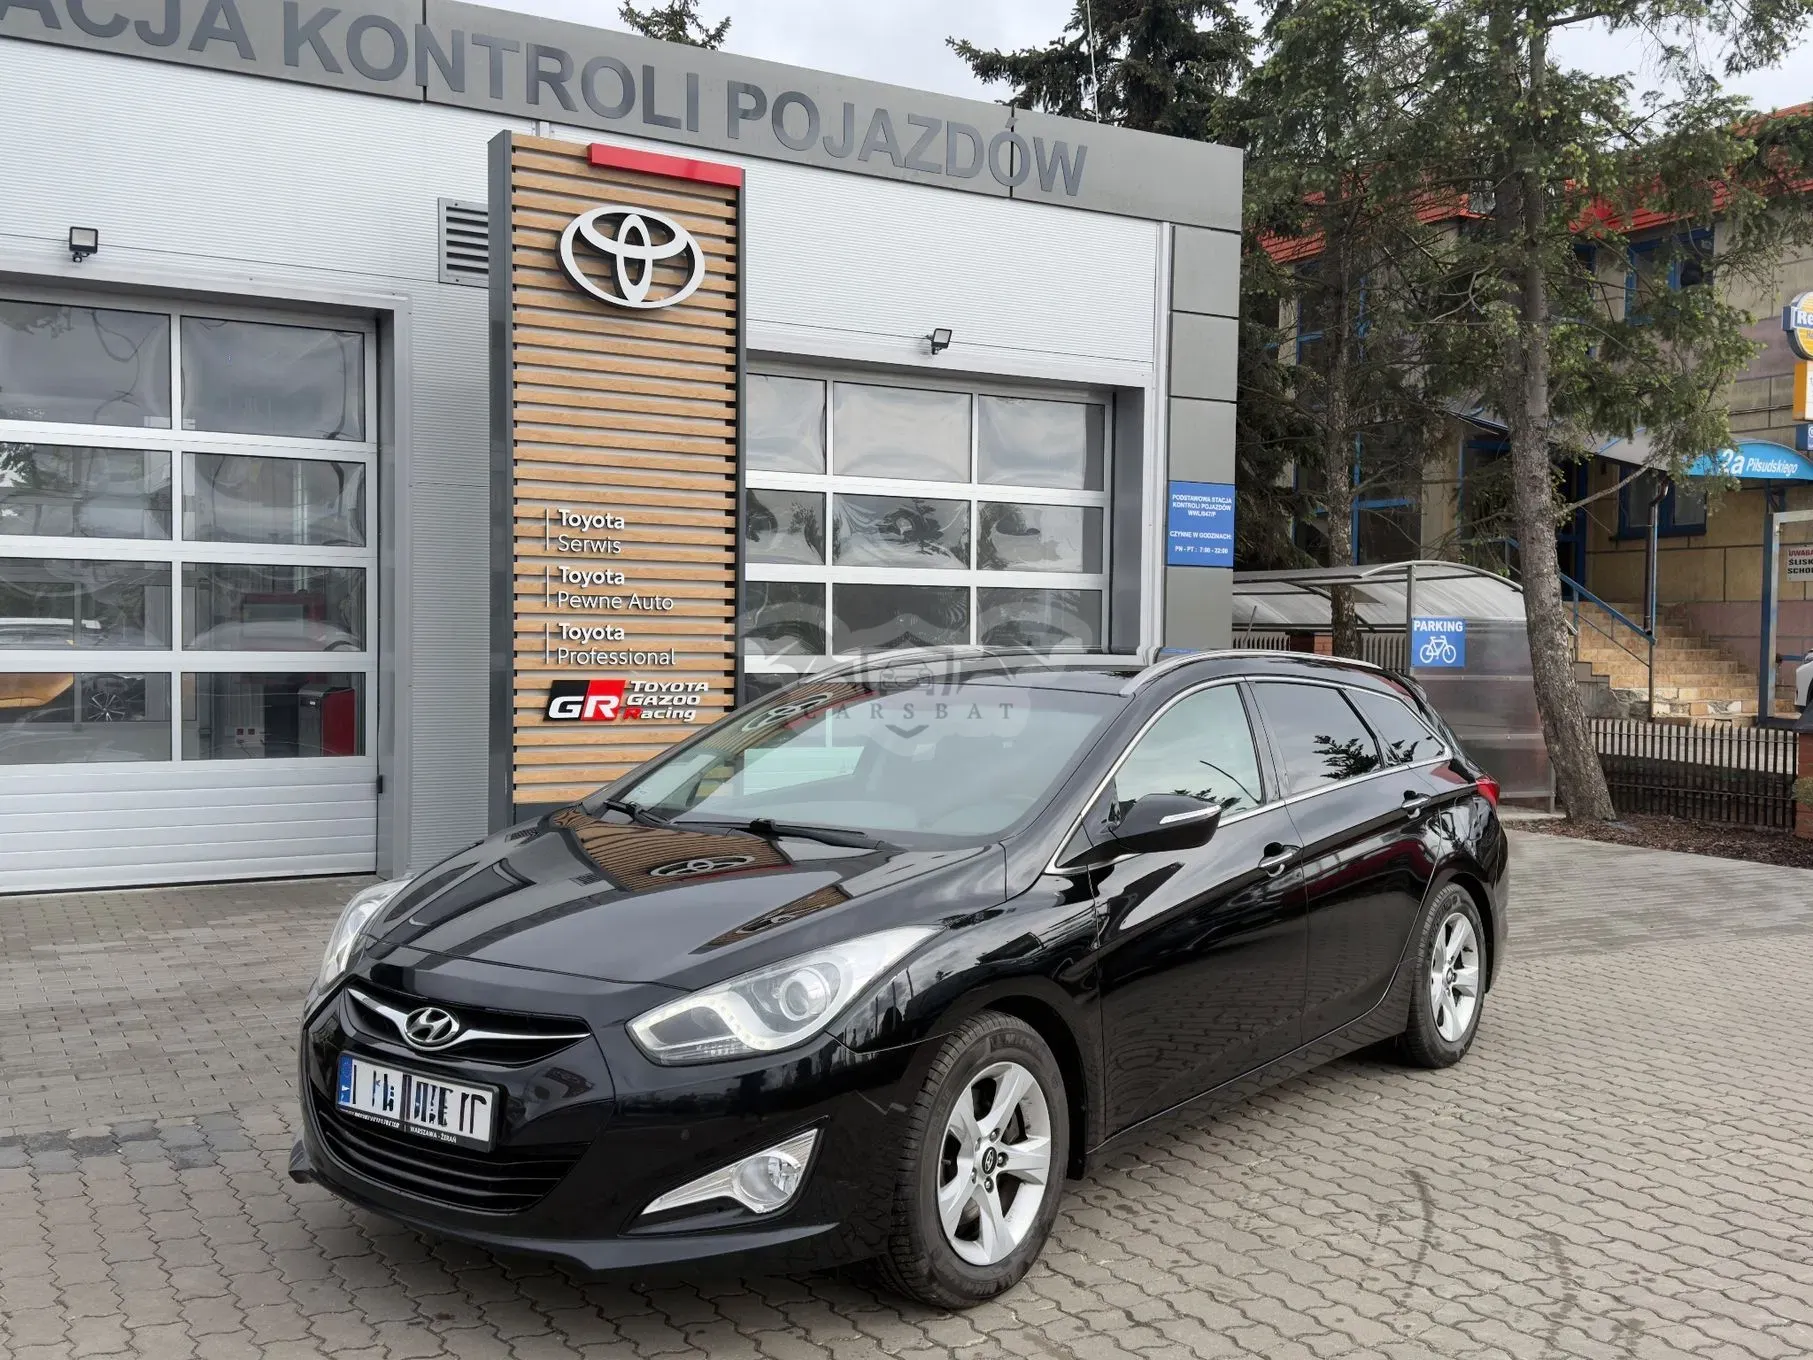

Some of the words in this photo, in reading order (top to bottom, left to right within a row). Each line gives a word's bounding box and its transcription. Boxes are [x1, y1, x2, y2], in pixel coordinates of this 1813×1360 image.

[283, 0, 699, 133] KONTROLI
[727, 80, 1088, 197] POJAZDÓW
[558, 508, 625, 532] Toyota
[558, 534, 621, 554] Serwis
[558, 565, 625, 588] Toyota
[557, 591, 622, 609] Pewne
[628, 593, 674, 611] Auto
[558, 622, 625, 644] Toyota
[1413, 620, 1463, 632] PARKING
[557, 648, 676, 666] Professional
[629, 680, 709, 692] TOYOTA
[548, 696, 620, 720] GR
[626, 694, 701, 706] GAZOO
[623, 707, 697, 722] Racing
[410, 1126, 438, 1138] WARSZAWA
